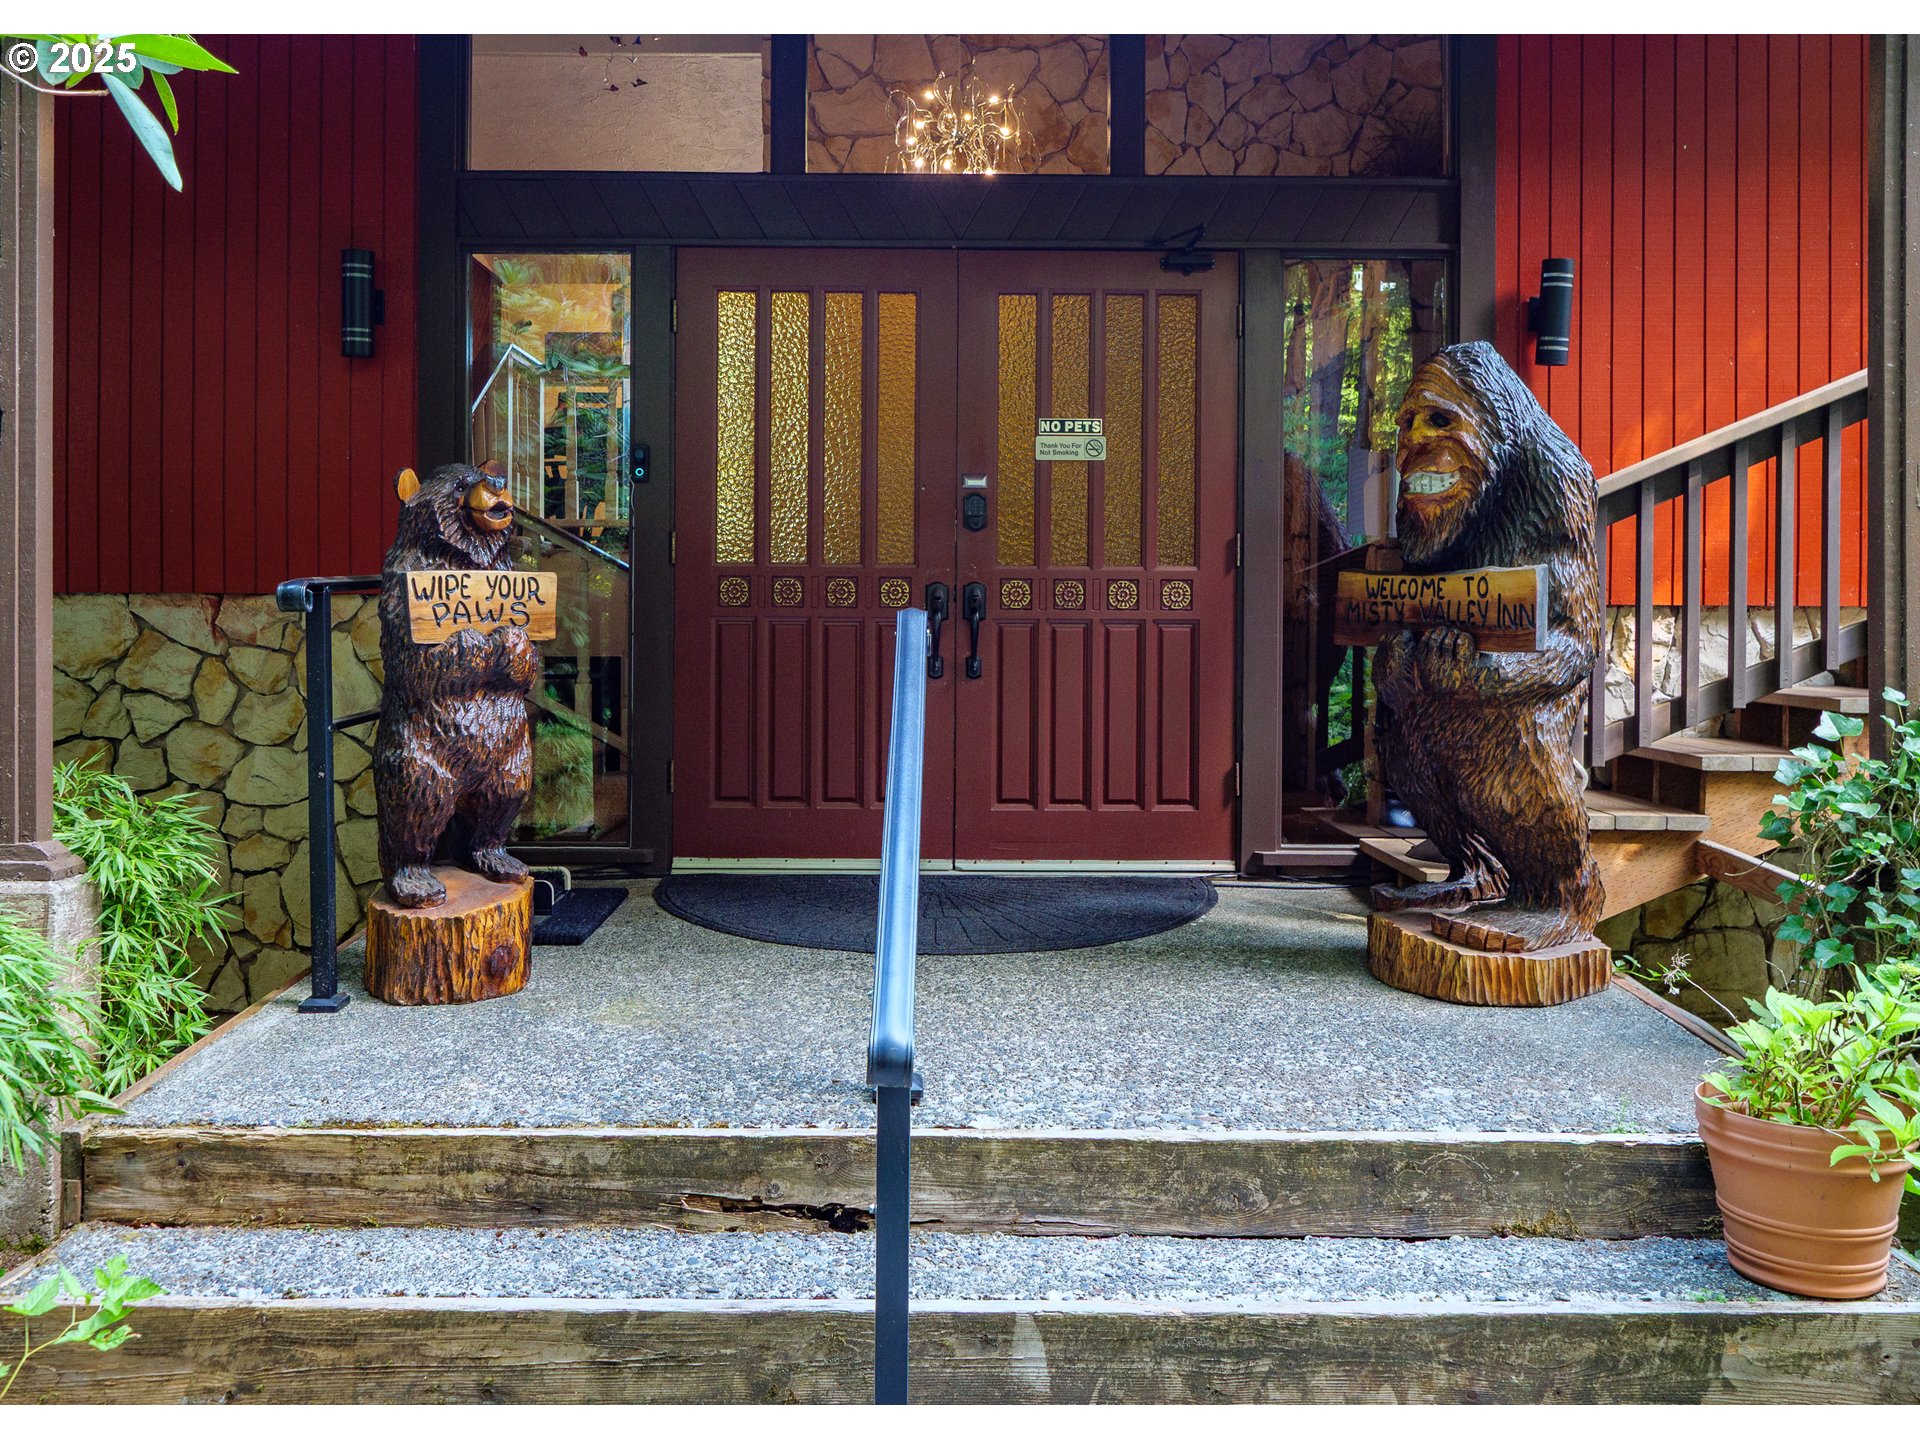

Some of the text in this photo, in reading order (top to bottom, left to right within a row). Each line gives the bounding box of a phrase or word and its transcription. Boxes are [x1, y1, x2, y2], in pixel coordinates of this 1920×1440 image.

[1040, 420, 1101, 433] NO PETS
[1052, 449, 1079, 457] Smoking
[411, 573, 546, 606] WIPE YOUR
[1365, 575, 1489, 600] WELCOME TO
[432, 600, 531, 629] PAWS
[1346, 593, 1538, 630] MISTY VALLEY INN
